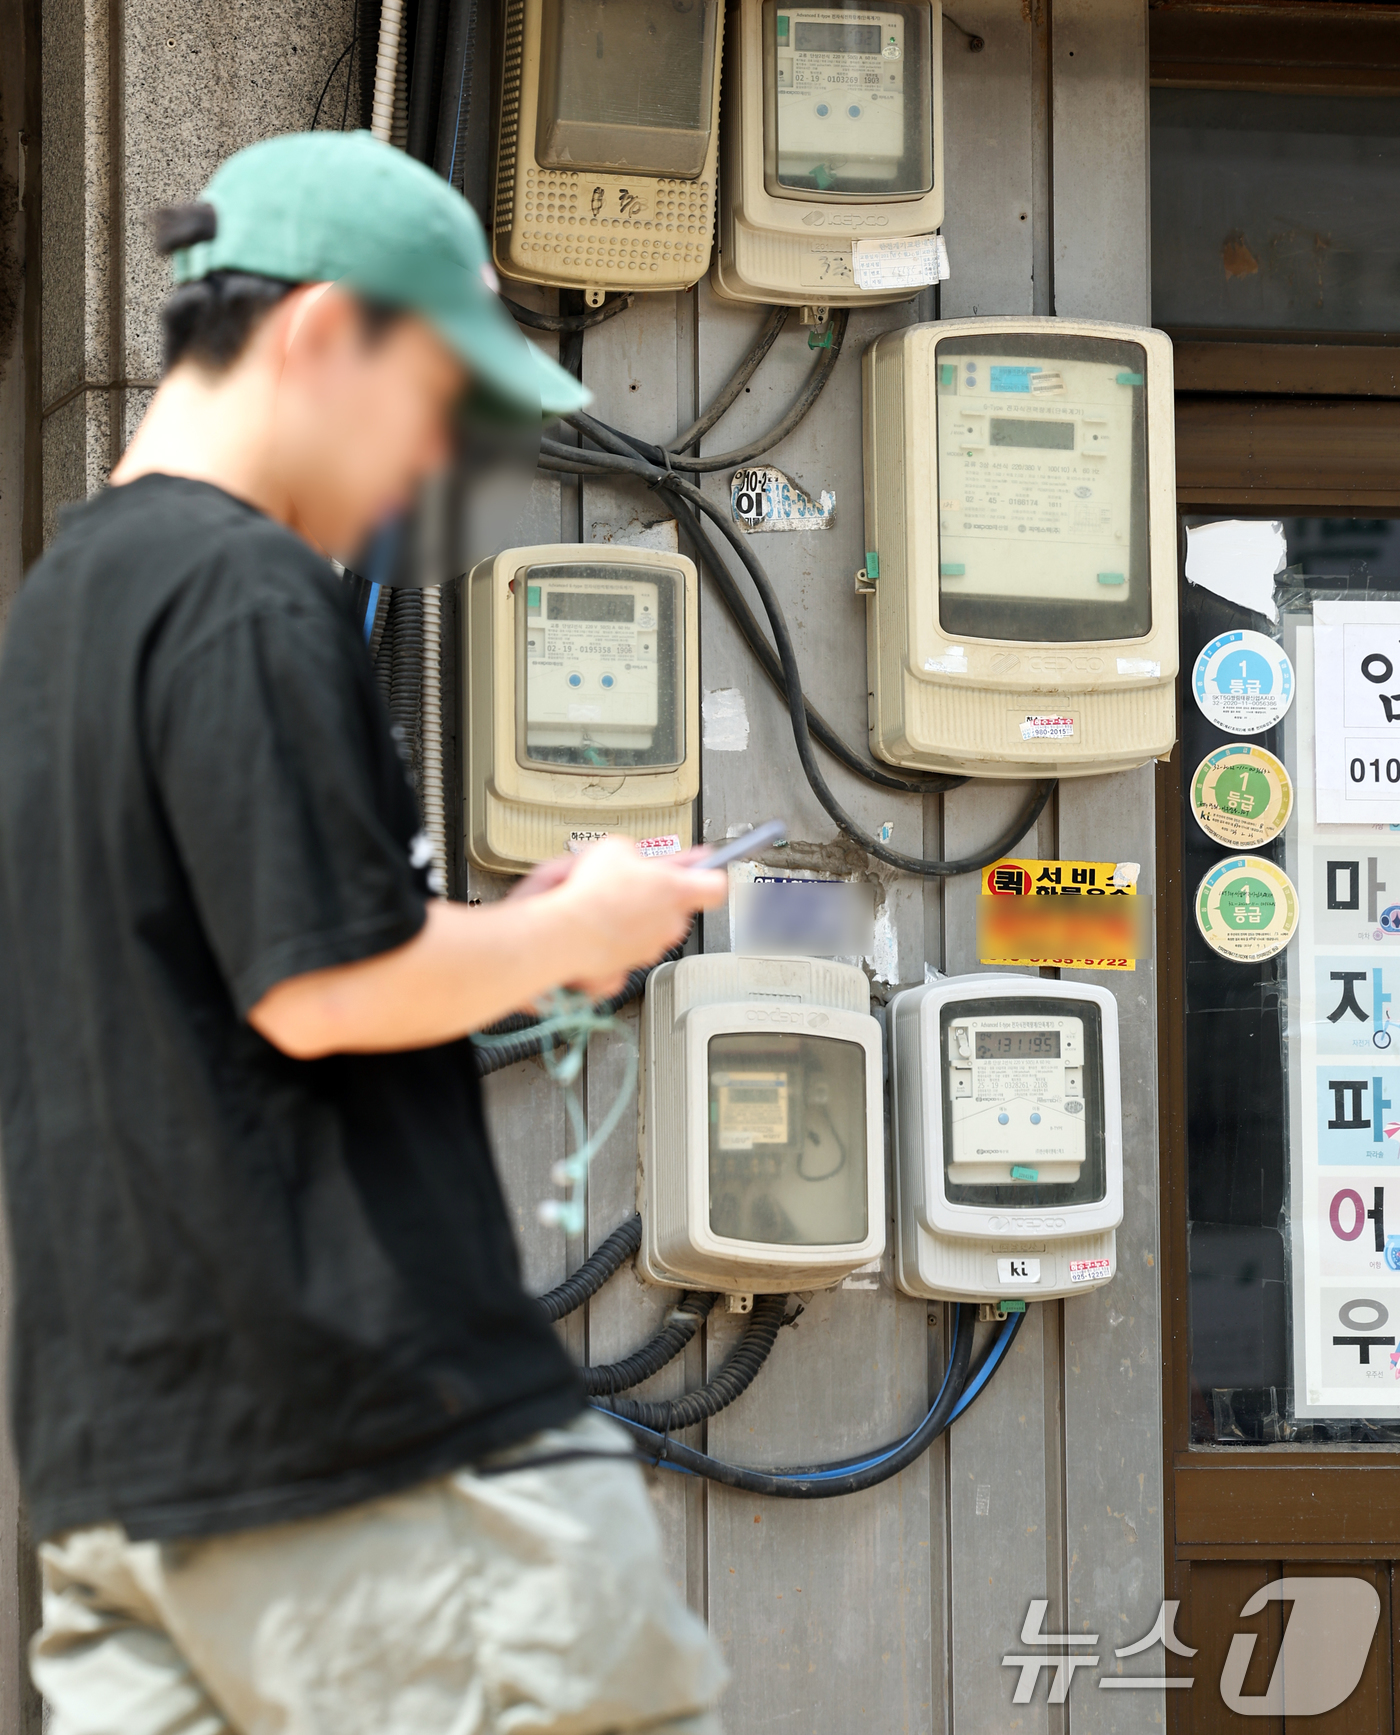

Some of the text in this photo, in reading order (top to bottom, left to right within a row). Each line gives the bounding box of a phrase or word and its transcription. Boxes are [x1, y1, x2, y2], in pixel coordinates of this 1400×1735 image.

[1239, 660, 1247, 678] 1
[1229, 679, 1261, 695] 등급
[1350, 758, 1400, 783] 010
[1239, 772, 1249, 791] 1
[1227, 791, 1255, 812] 등급
[995, 870, 1023, 895] 퀵
[1327, 857, 1386, 922] 마
[1240, 885, 1250, 904] 1
[1233, 906, 1262, 923] 등급
[1358, 932, 1370, 940] 마차
[1326, 968, 1391, 1032] 자
[1352, 1039, 1370, 1047] 자전거
[1328, 1077, 1392, 1142] 파
[1366, 1150, 1384, 1158] 파라솔
[1329, 1187, 1384, 1252] 어
[1369, 1261, 1381, 1269] 어항
[1332, 1299, 1395, 1364] 우
[1366, 1370, 1384, 1379] 우주선
